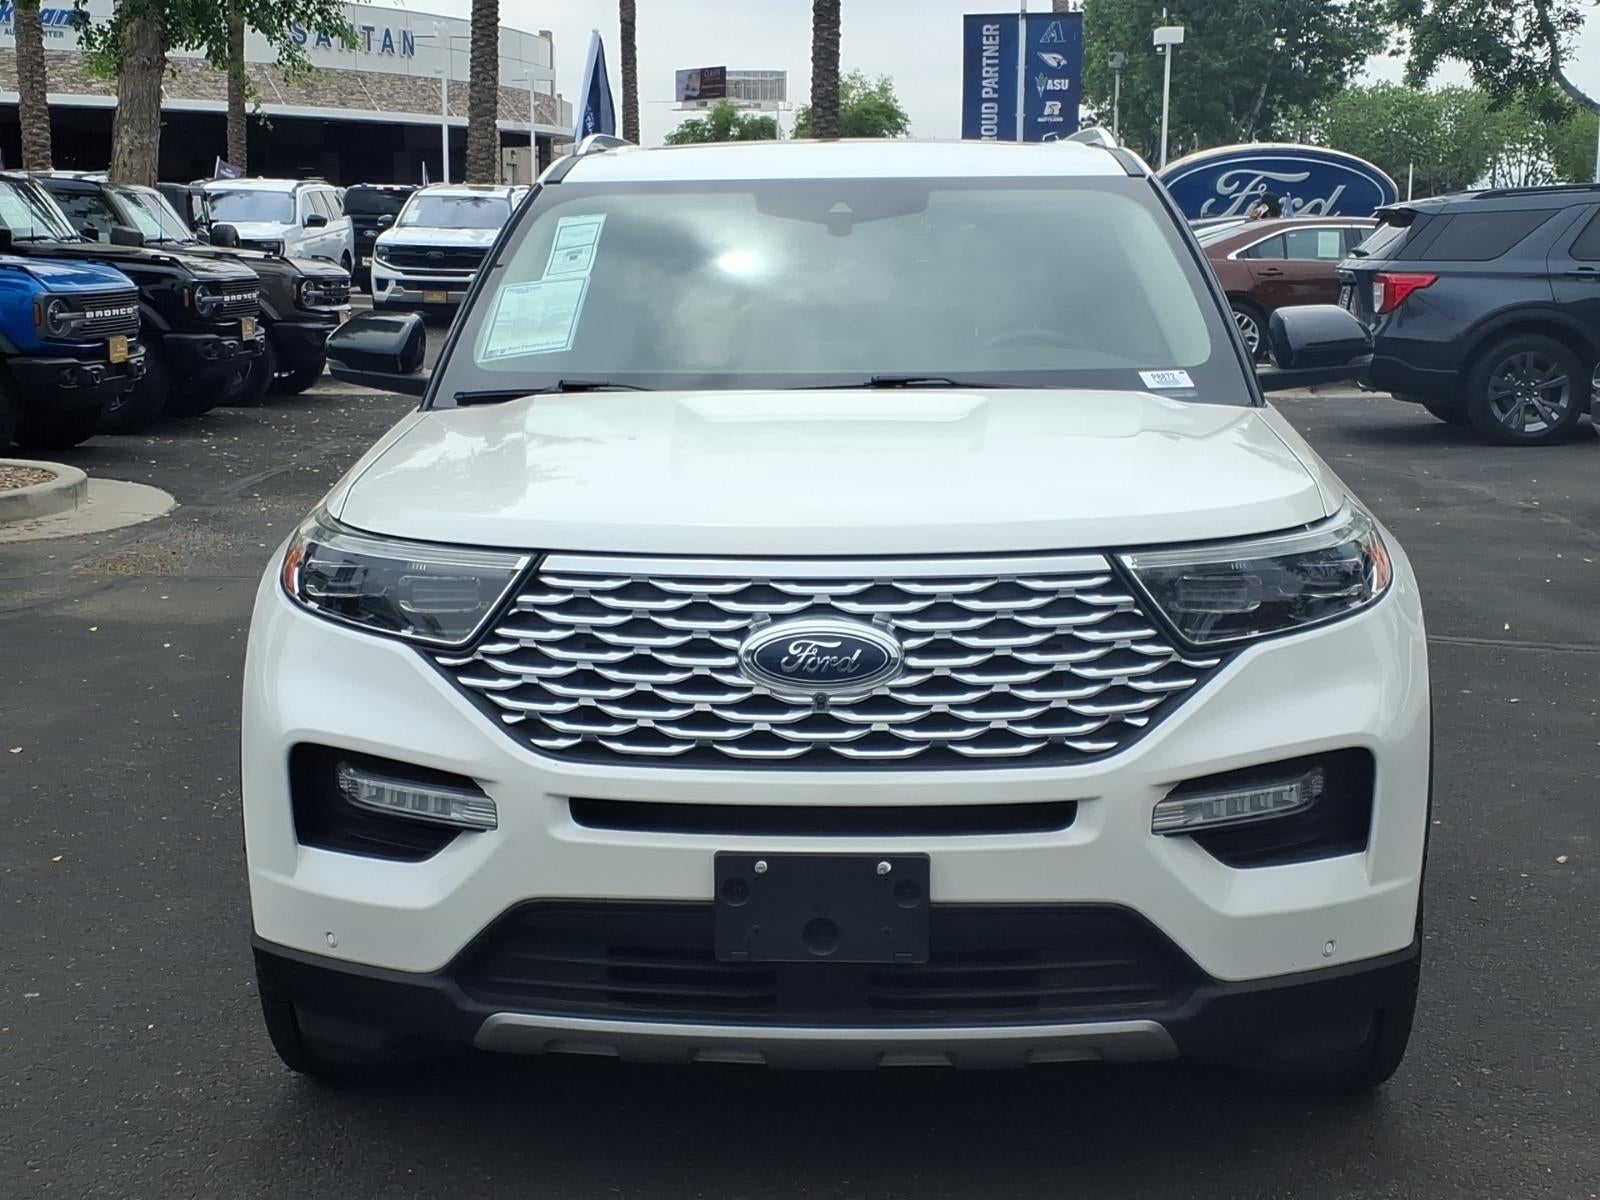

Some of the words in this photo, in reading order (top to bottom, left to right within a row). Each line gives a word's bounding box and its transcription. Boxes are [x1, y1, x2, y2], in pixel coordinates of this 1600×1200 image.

[982, 24, 999, 98] PARTNER
[1046, 80, 1069, 90] ASU
[1201, 169, 1346, 217] Frd
[86, 307, 133, 318] BRONCO
[780, 639, 862, 673] Ford
